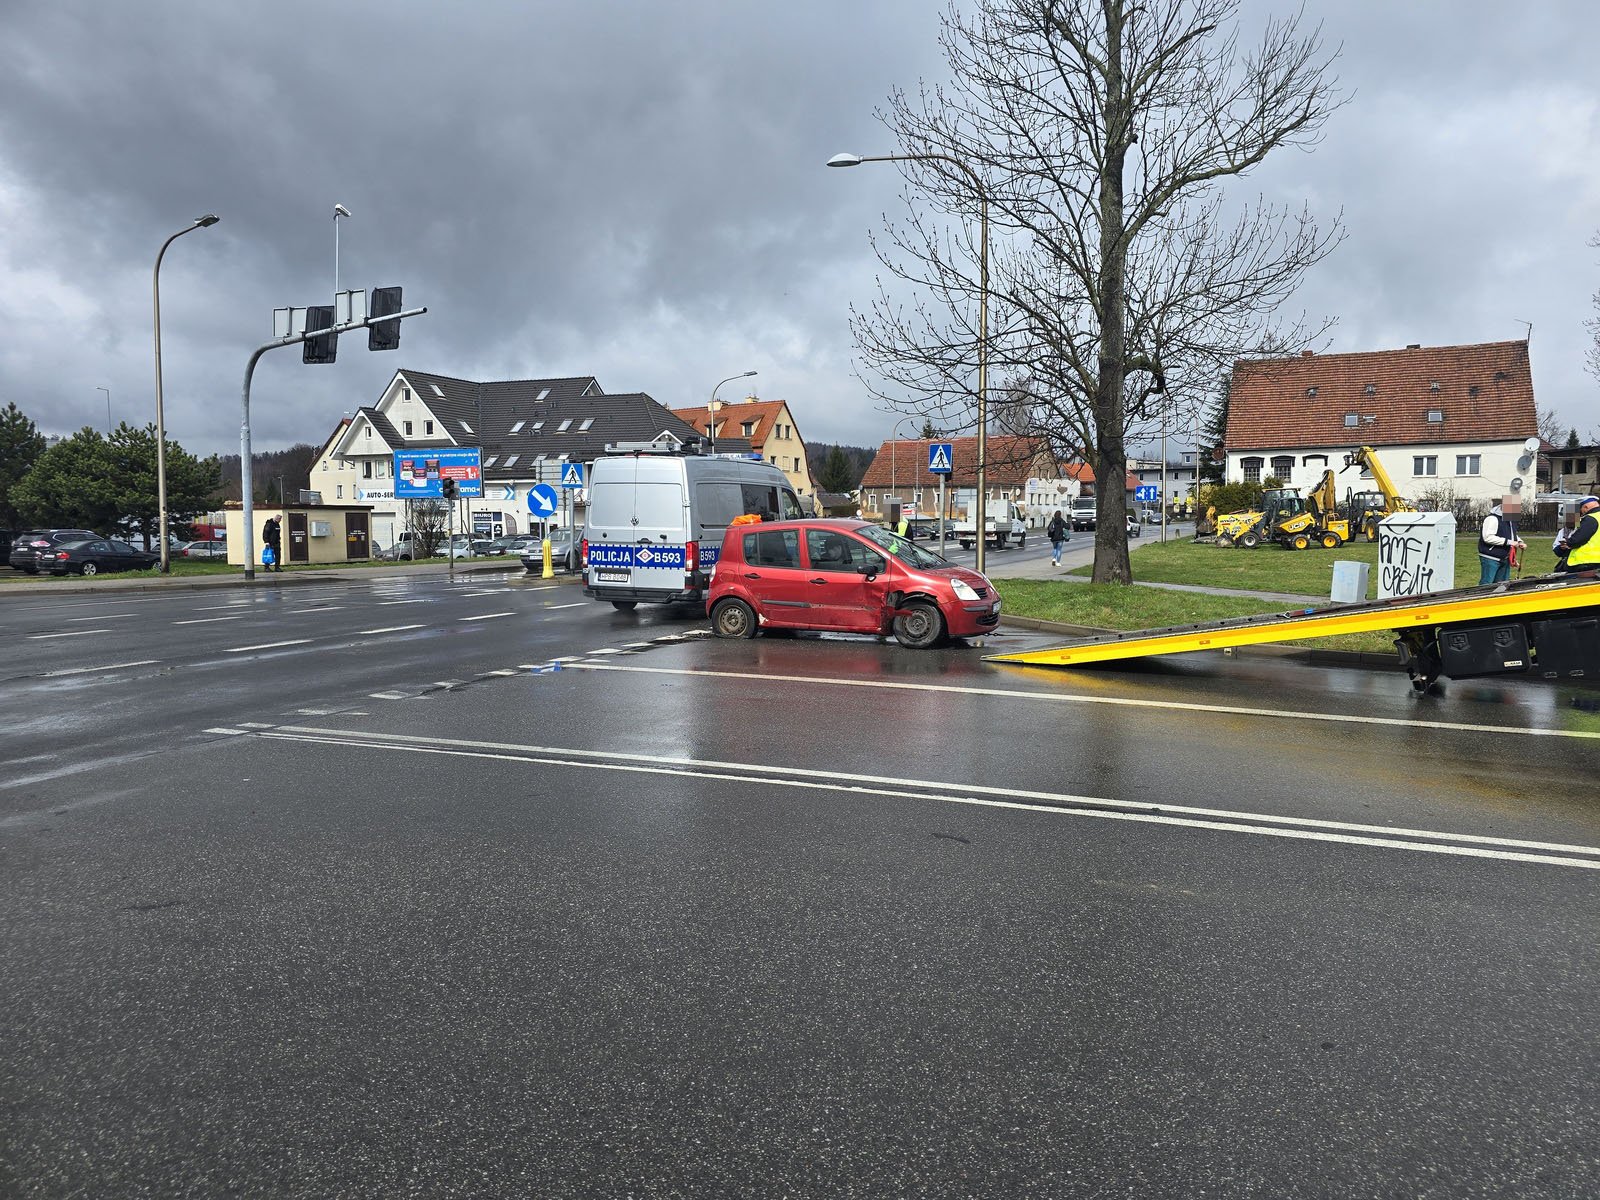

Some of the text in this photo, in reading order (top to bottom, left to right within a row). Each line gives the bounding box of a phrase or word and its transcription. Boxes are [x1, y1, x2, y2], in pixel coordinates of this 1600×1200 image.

[590, 550, 631, 562] POLICJA
[654, 552, 681, 563] B593
[700, 550, 715, 561] B593
